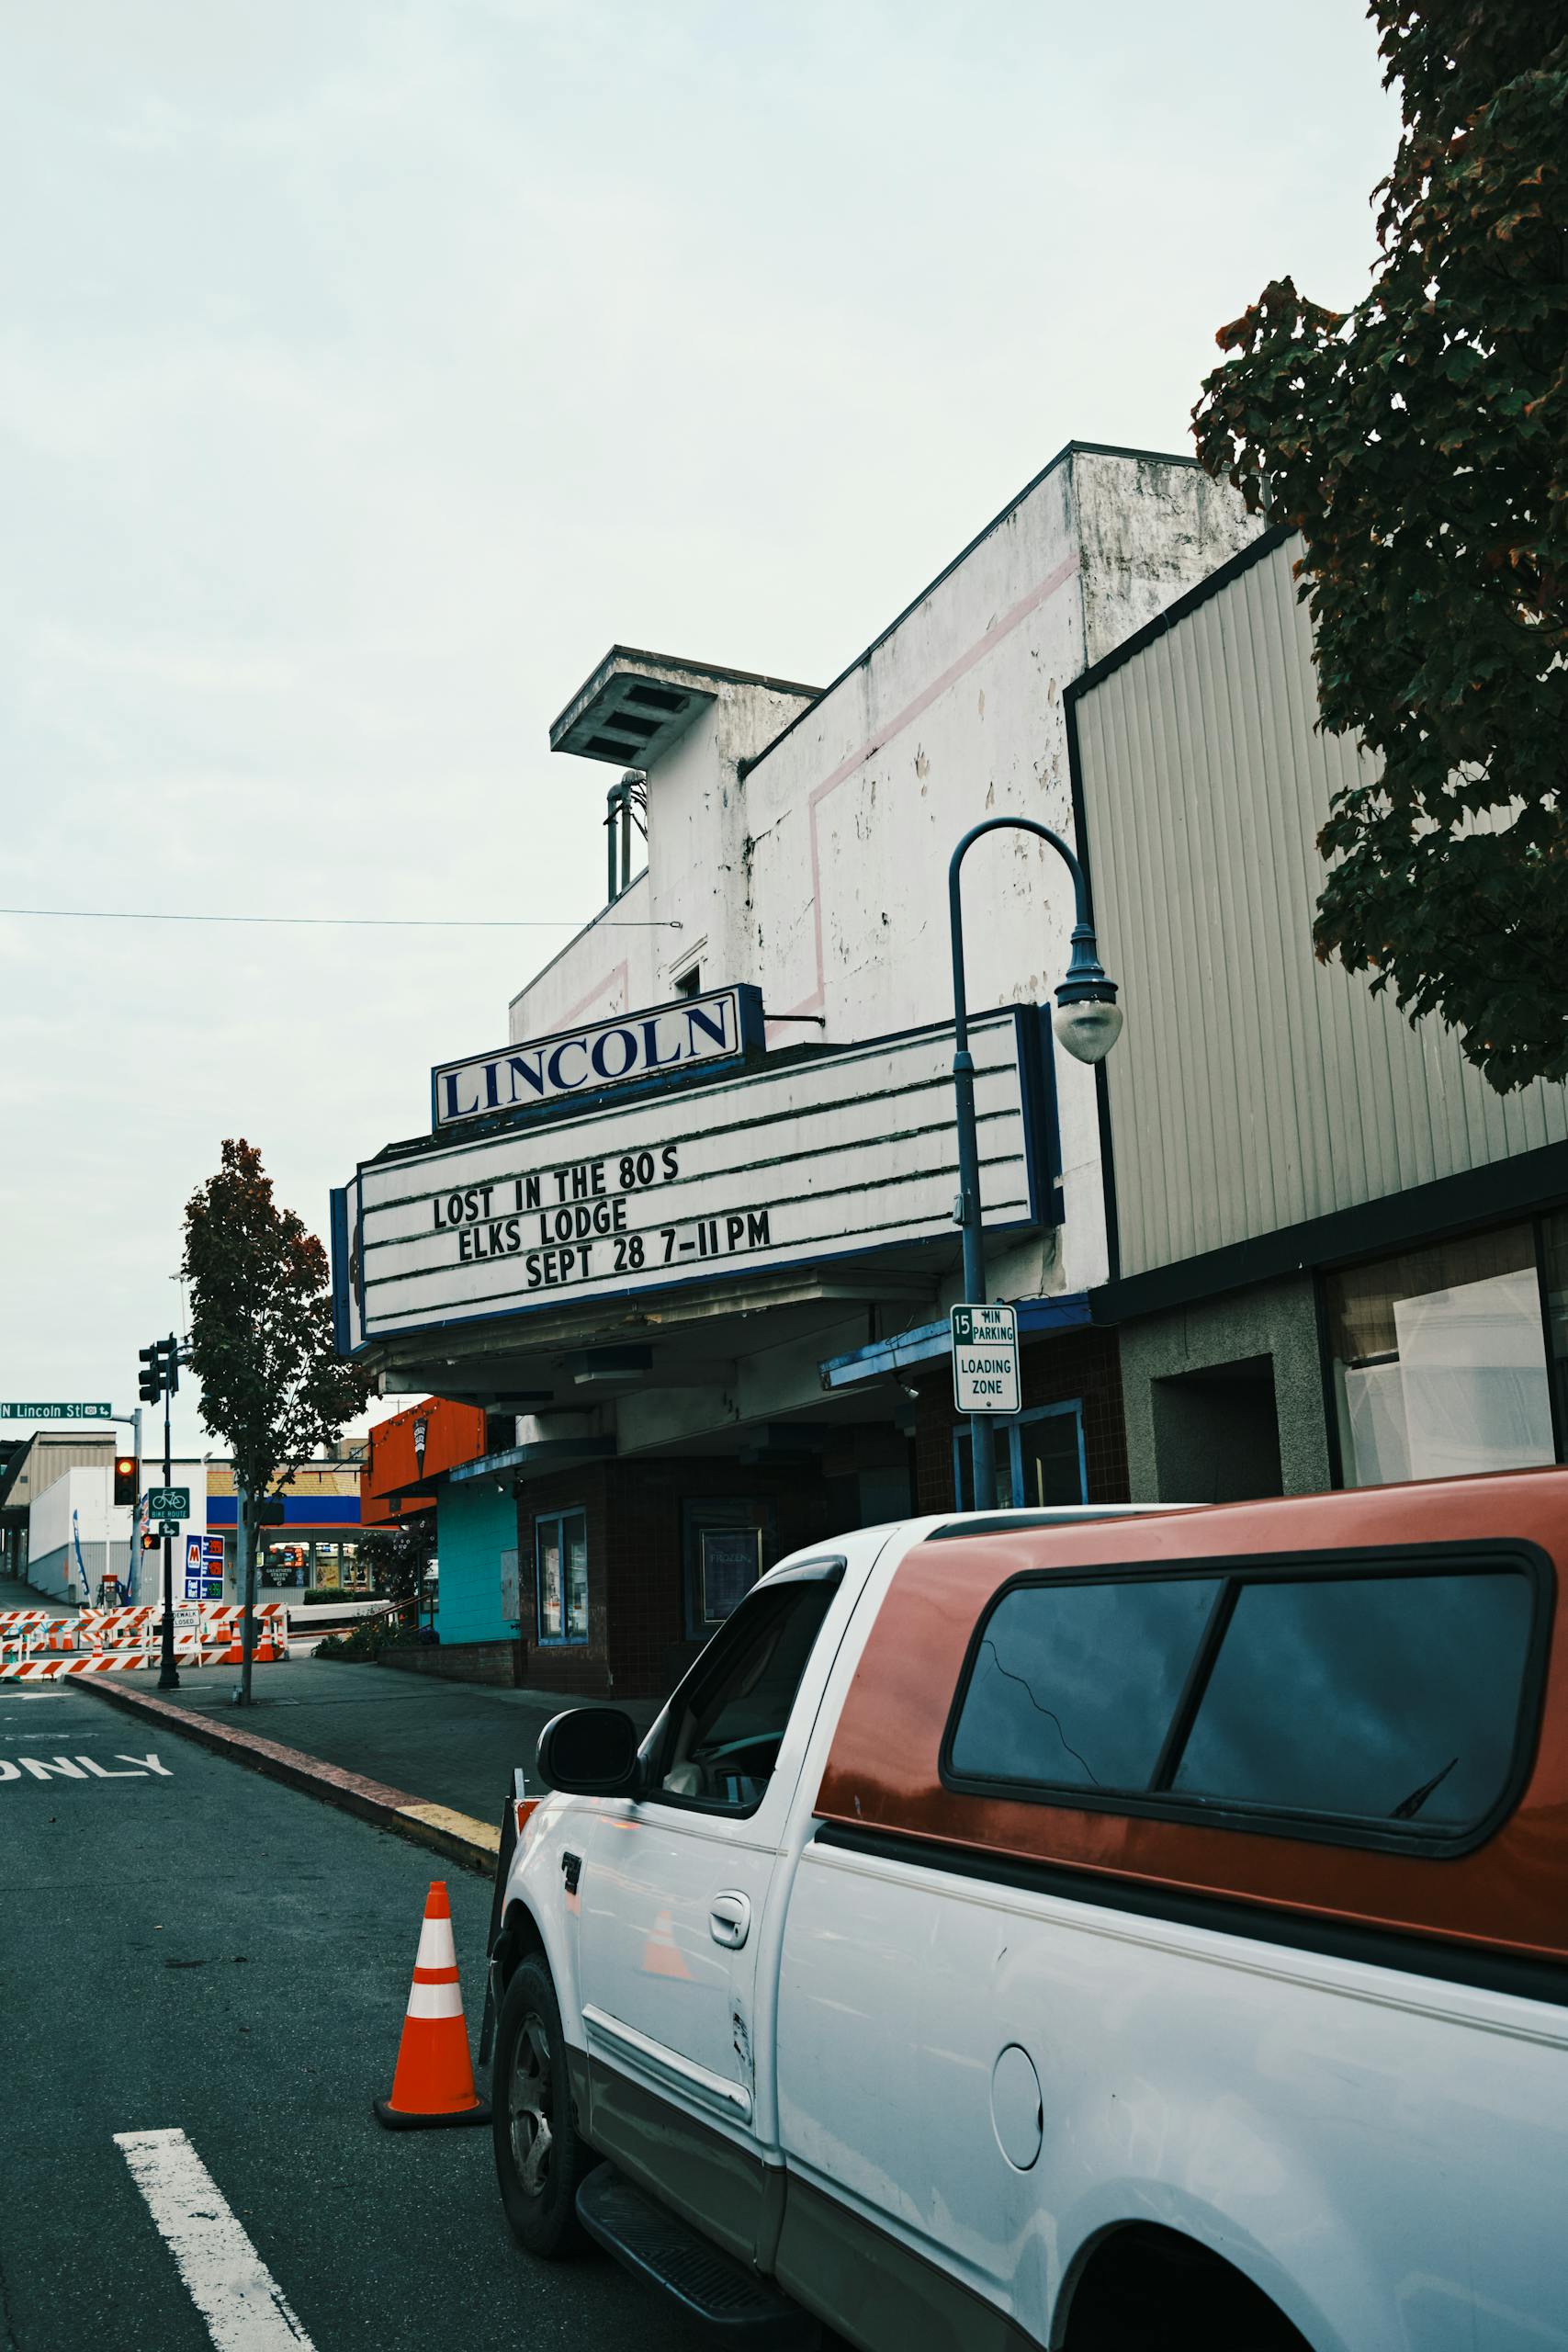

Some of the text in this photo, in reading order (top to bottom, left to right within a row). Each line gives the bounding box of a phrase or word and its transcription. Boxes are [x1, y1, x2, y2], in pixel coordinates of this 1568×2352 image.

[441, 1000, 728, 1120] LINCOLN
[434, 1186, 494, 1229] LOST
[516, 1176, 541, 1211] IN
[554, 1162, 606, 1203] THE
[459, 1198, 627, 1262] ELKS LODGE
[526, 1245, 592, 1287] SEPT
[615, 1236, 645, 1272] 28
[955, 1315, 970, 1335] 15
[983, 1311, 1000, 1323] MIN
[974, 1327, 1014, 1340] PARKING
[962, 1360, 1011, 1374] LOADING
[973, 1380, 1003, 1395] ZONE
[2, 1405, 80, 1417] N Lincoln St
